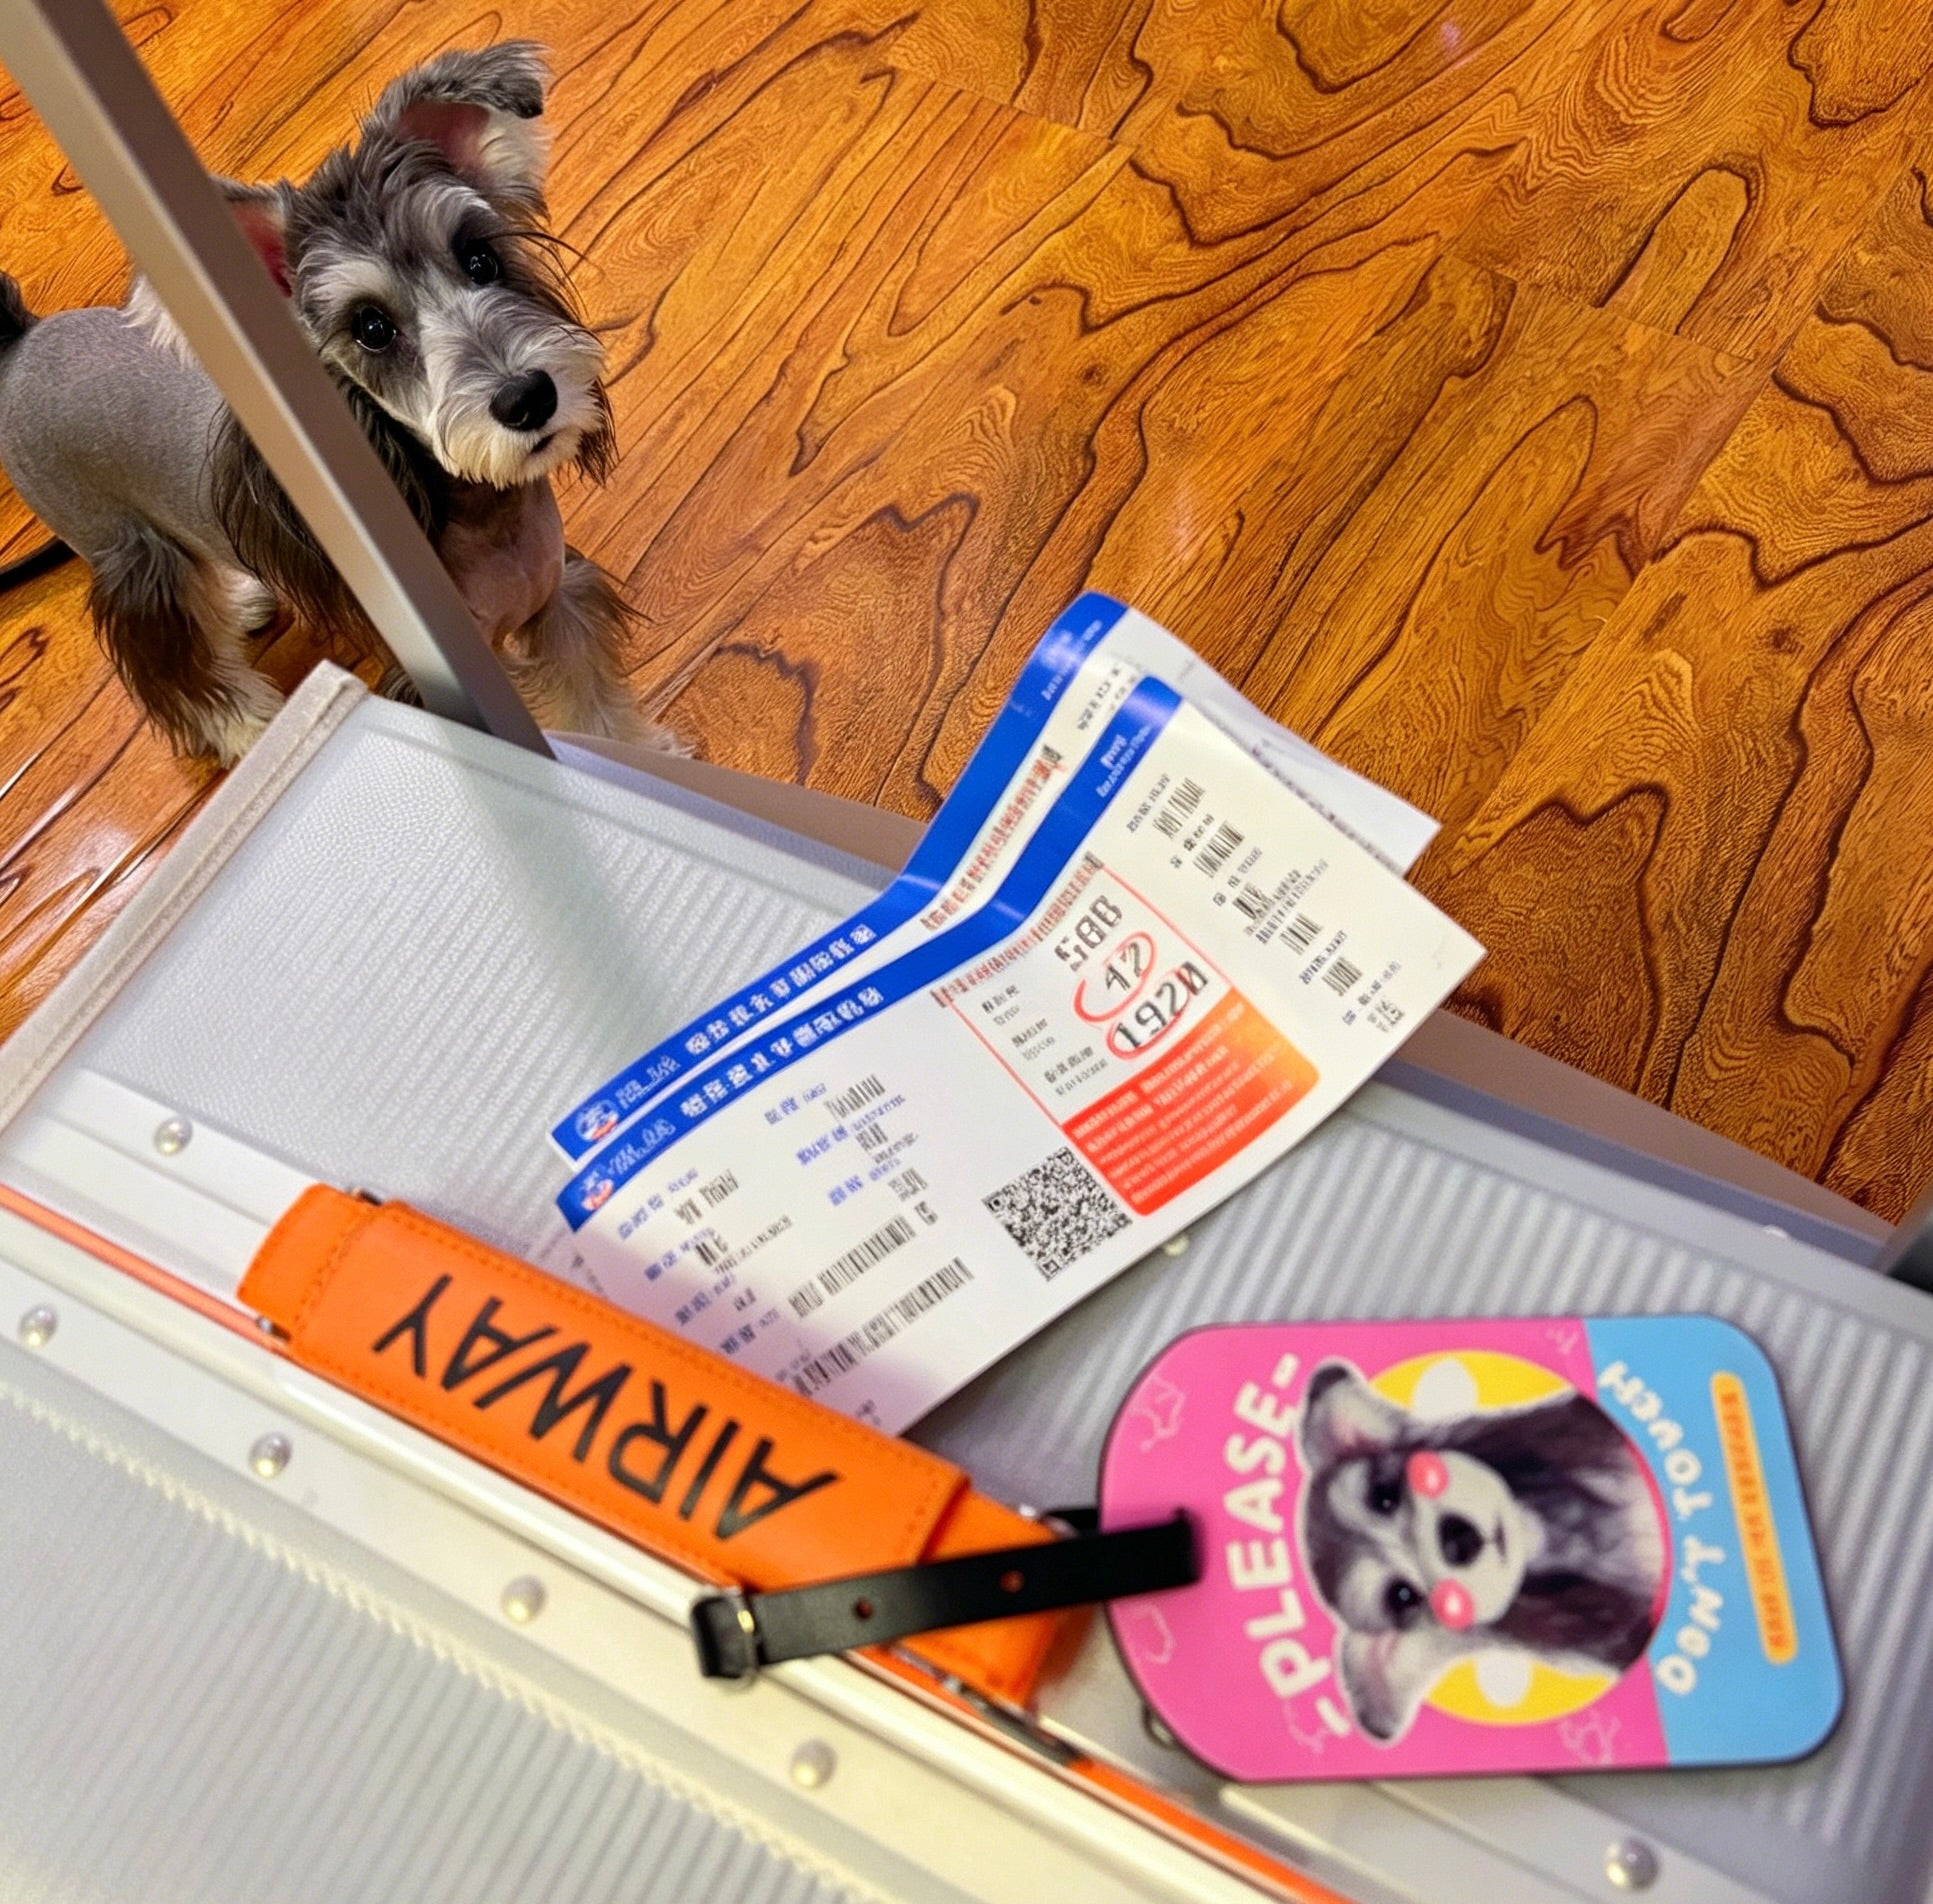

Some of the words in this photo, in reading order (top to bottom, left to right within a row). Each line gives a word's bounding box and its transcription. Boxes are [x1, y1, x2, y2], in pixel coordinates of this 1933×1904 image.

[373, 1274, 845, 1541] AIRWAY
[1599, 1361, 1714, 1521] TOUCH
[1656, 1536, 1725, 1696] DON'T
